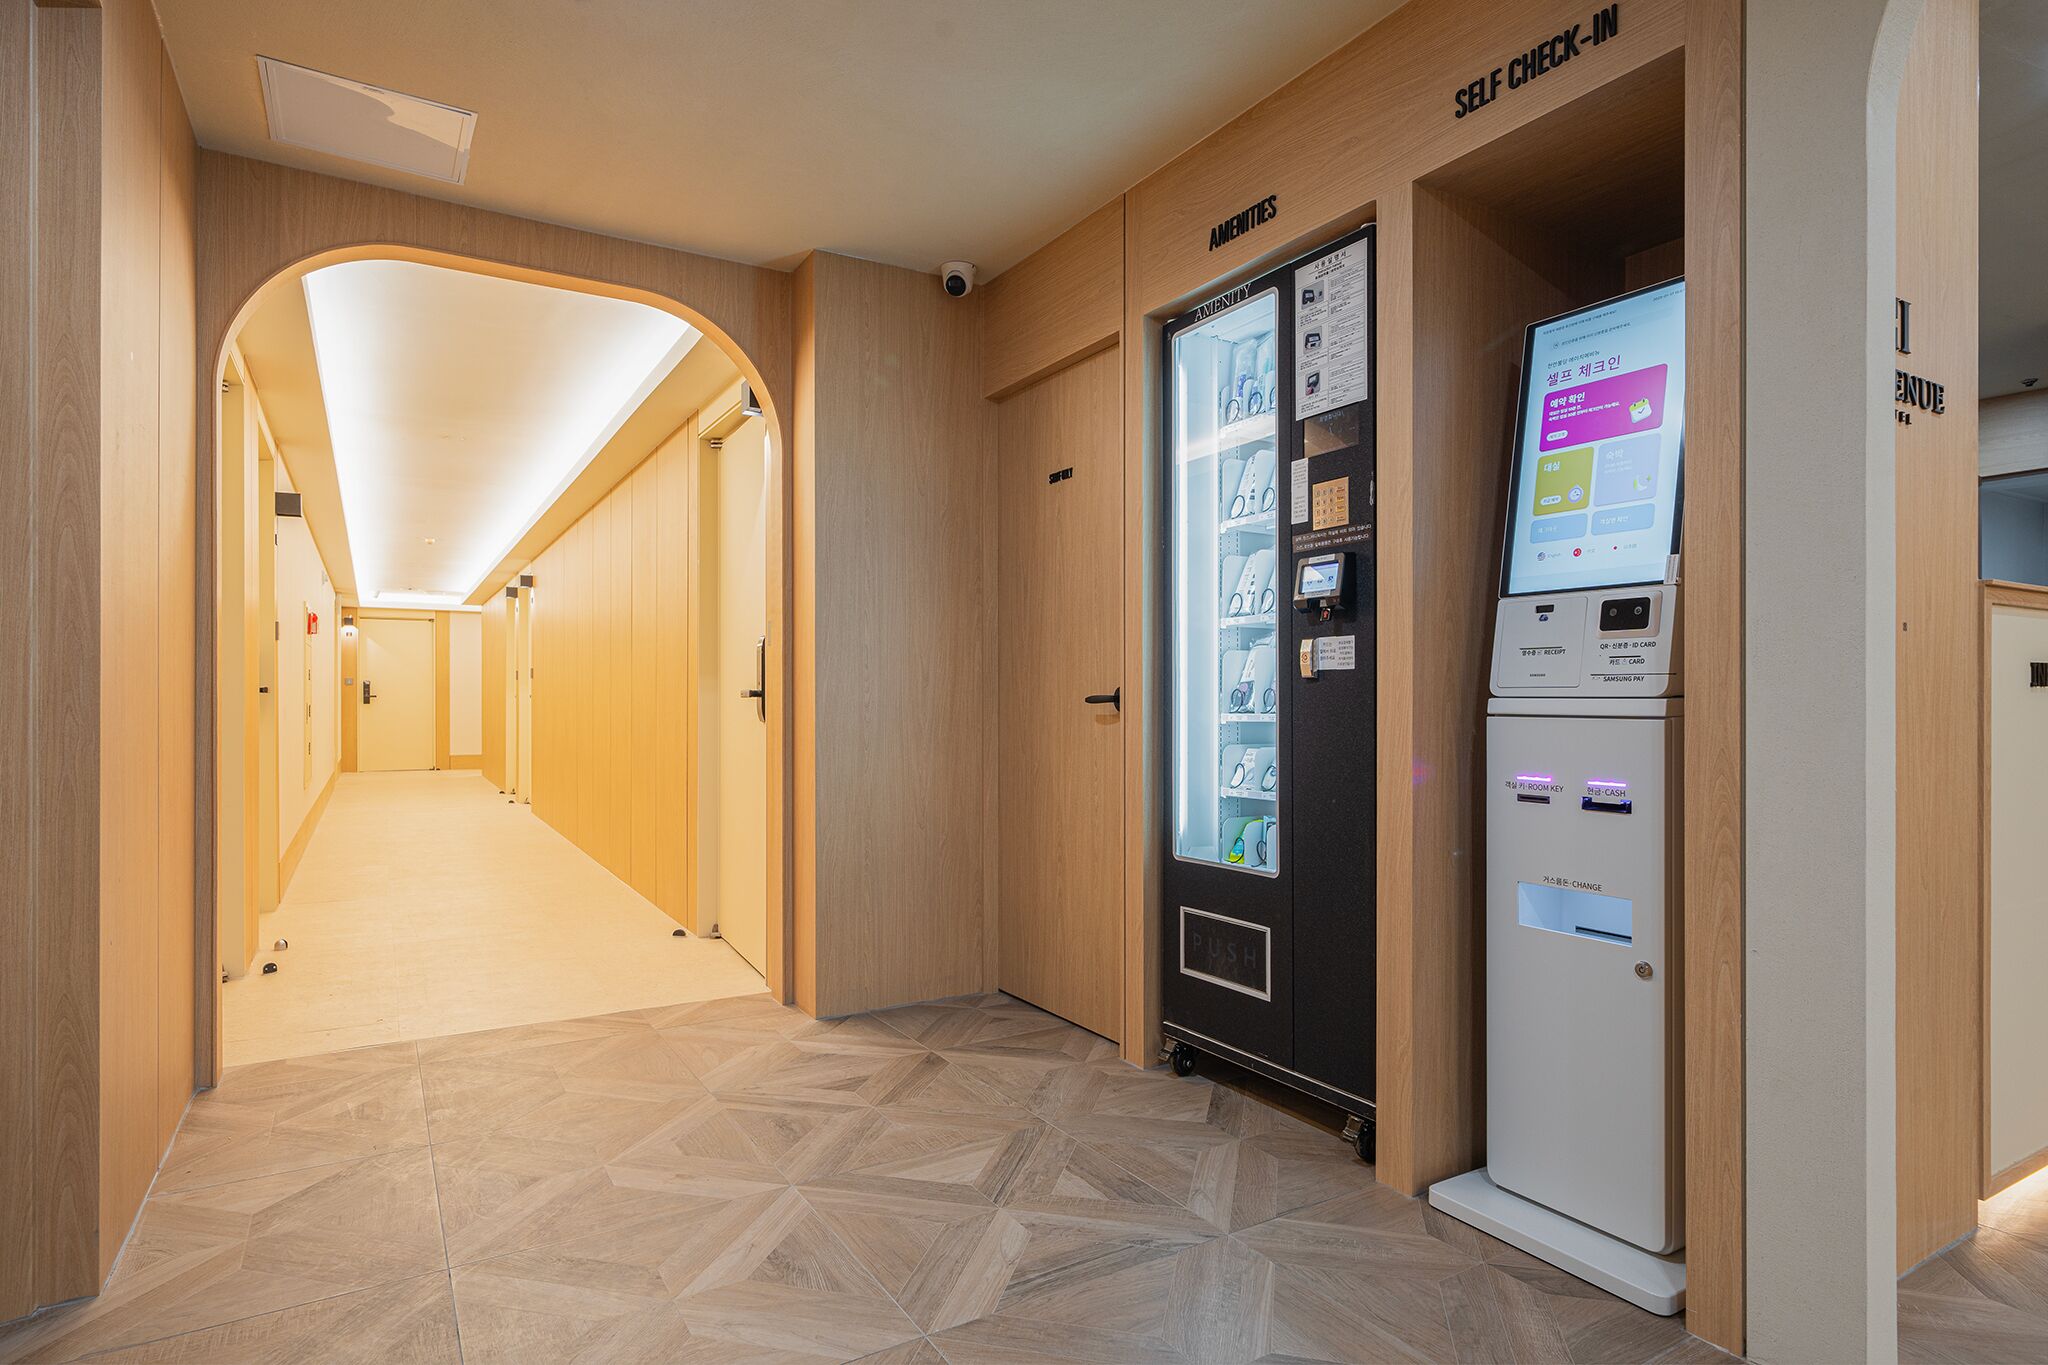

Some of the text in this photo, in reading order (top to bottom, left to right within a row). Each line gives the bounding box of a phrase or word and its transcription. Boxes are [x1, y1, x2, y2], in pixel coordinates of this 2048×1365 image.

[1455, 3, 1618, 119] SELF CHECK-IN
[1208, 194, 1277, 252] AMENITIES
[1194, 283, 1251, 322] AMENITY
[1546, 355, 1621, 387] 셀프 체크인
[1550, 391, 1586, 408] 예약 확인
[1193, 931, 1256, 969] PUSH
